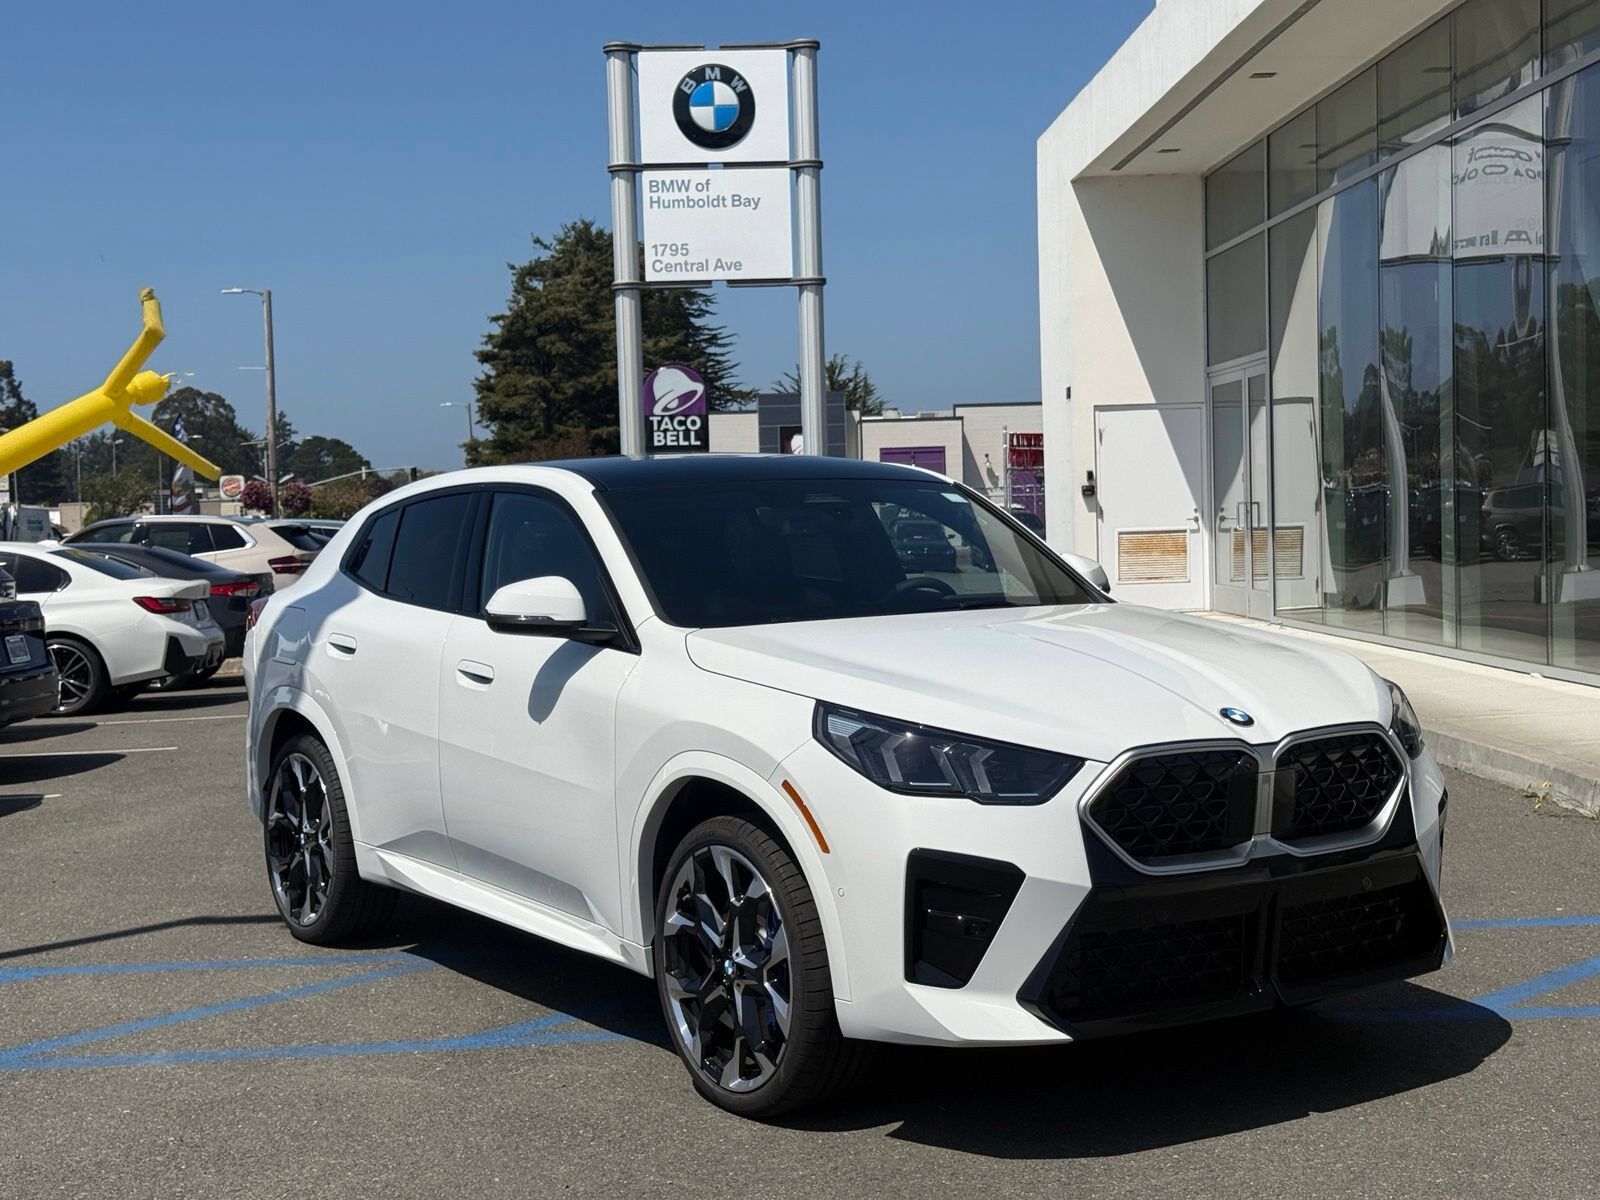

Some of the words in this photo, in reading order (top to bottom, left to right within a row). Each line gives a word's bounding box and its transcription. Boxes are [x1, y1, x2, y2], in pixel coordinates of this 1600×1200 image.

[680, 66, 747, 95] BMW
[648, 180, 691, 193] BMW
[695, 179, 711, 193] of
[649, 195, 727, 210] Humboldt
[731, 194, 761, 210] Bay
[652, 244, 689, 257] 1795
[651, 259, 709, 273] Central
[713, 258, 743, 271] Ave
[649, 416, 701, 431] TACO
[653, 431, 701, 446] BELL
